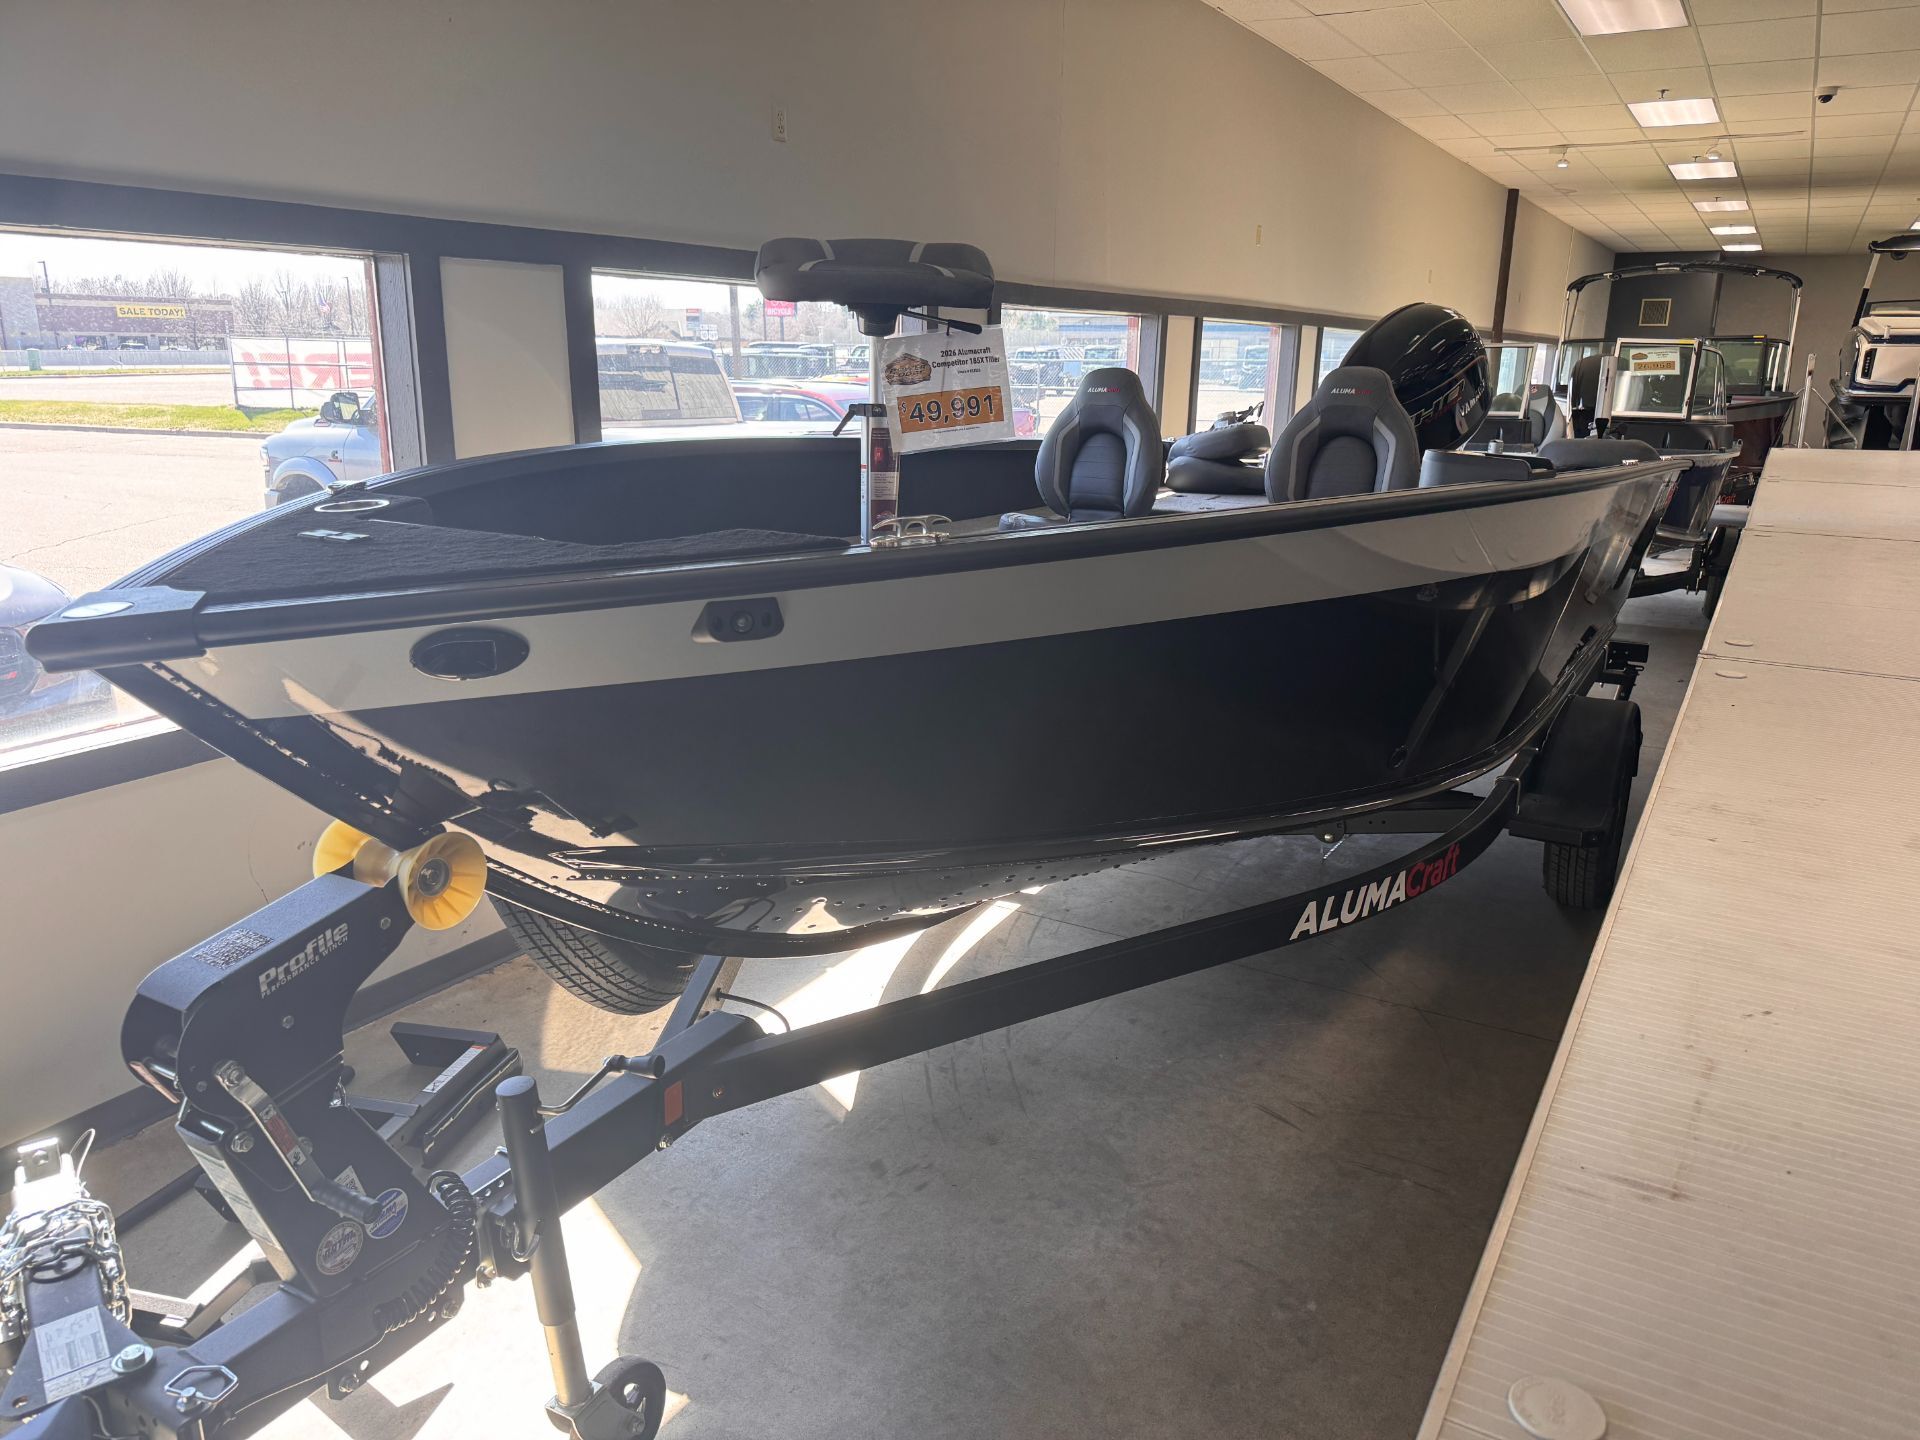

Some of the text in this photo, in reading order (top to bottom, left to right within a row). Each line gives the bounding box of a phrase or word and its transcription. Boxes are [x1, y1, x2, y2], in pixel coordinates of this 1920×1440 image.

[118, 306, 185, 318] SALE TODAY!
[767, 307, 792, 316] BICYCLE
[940, 346, 991, 357] 2026 Alumacraft
[931, 358, 969, 369] Competitor
[1289, 842, 1461, 940] ALUMACraft
[259, 922, 349, 993] Profile
[261, 936, 349, 999] PERFORMANCE WINCH
